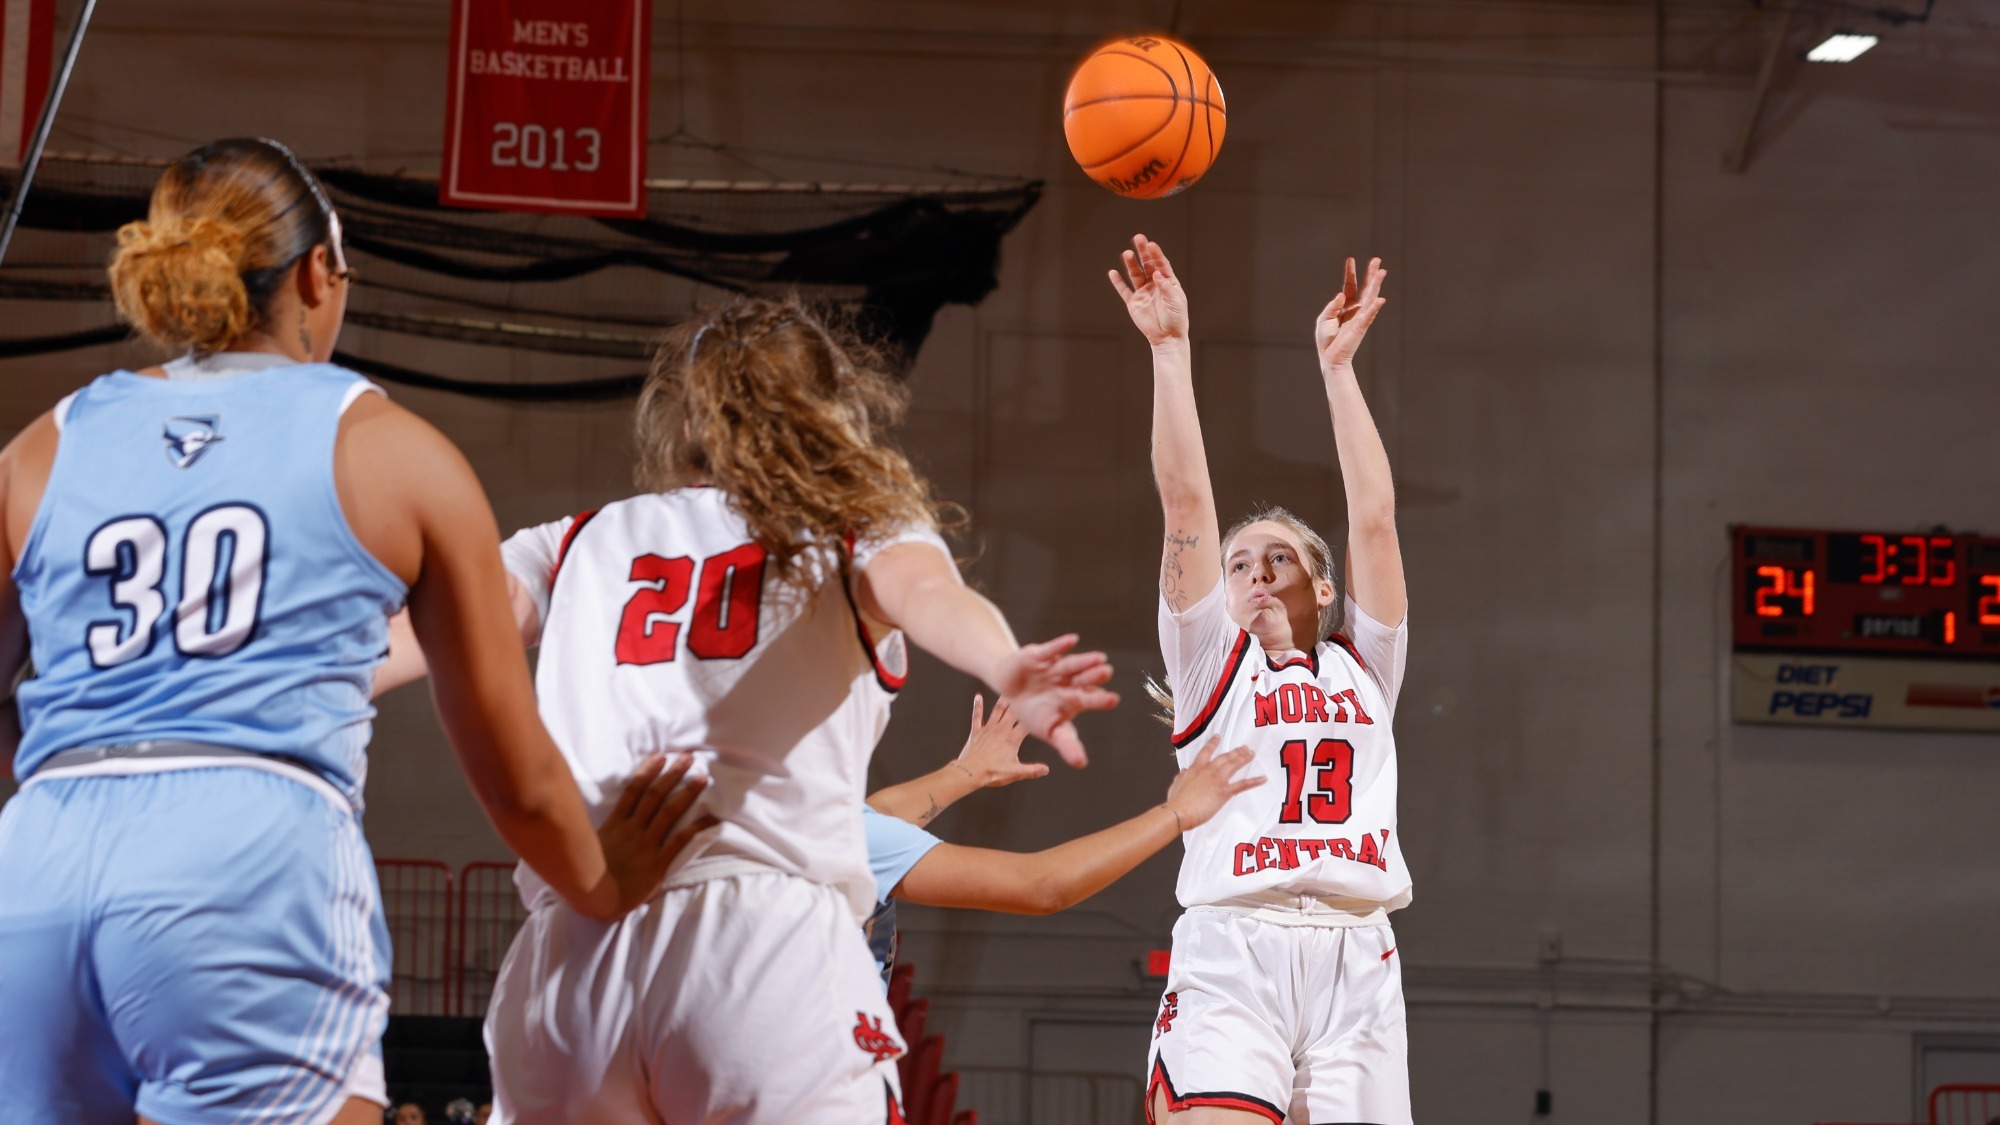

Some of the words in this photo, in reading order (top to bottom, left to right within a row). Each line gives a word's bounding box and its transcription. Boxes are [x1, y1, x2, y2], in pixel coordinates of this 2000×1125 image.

[512, 19, 589, 47] MEN'S
[470, 50, 629, 82] BASKETBALL
[492, 121, 601, 172] 2013
[1859, 533, 1955, 586] 3:35
[83, 501, 270, 670] 30
[614, 541, 767, 666] 20
[1755, 565, 1816, 616] 24
[1943, 611, 1956, 645] 1
[1776, 664, 1840, 685] DIET
[1769, 690, 1874, 719] PEPSI
[1279, 738, 1355, 824] 13
[1233, 829, 1390, 877] CENTRAL
